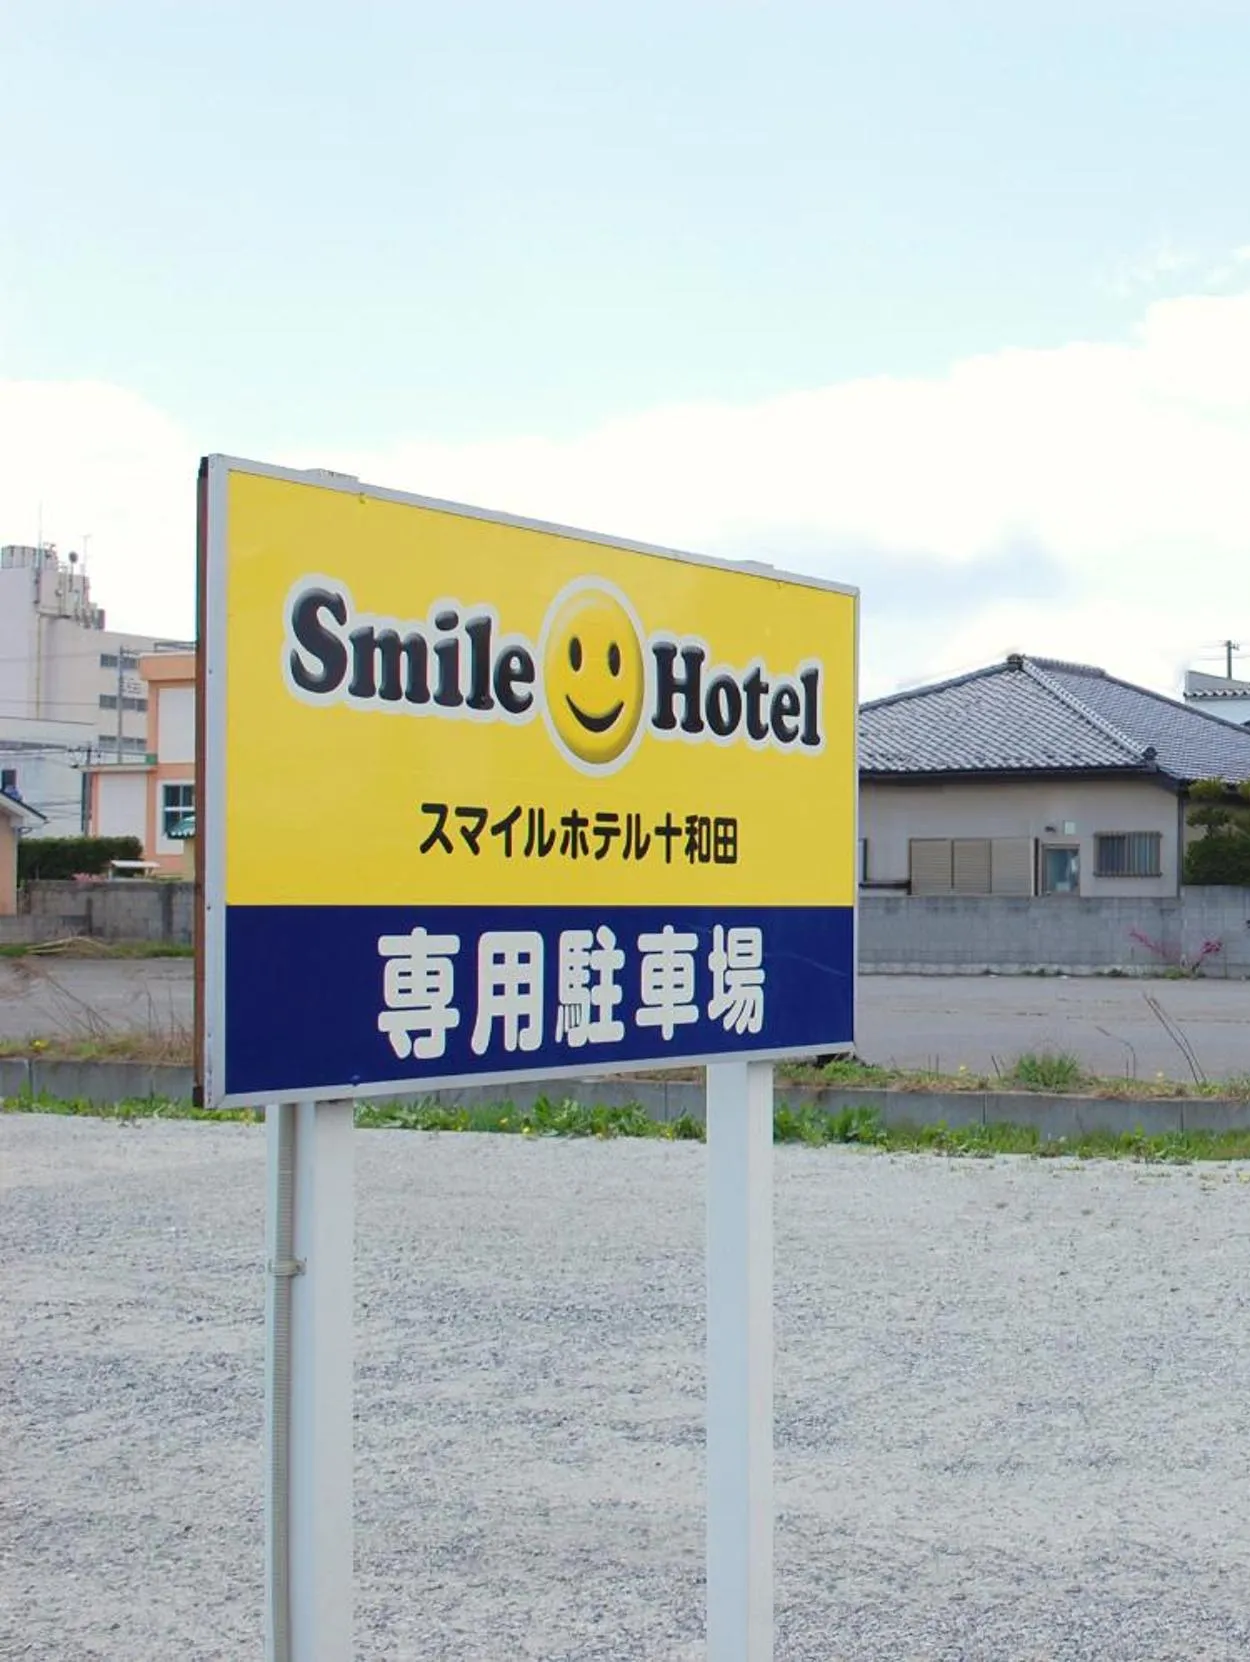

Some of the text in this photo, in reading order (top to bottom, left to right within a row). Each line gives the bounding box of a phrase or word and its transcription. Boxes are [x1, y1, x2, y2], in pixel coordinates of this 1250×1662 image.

[290, 588, 821, 747] Smile Hotel
[419, 802, 739, 865] スマイルホテル十和田
[377, 923, 766, 1060] 専用駐車場
